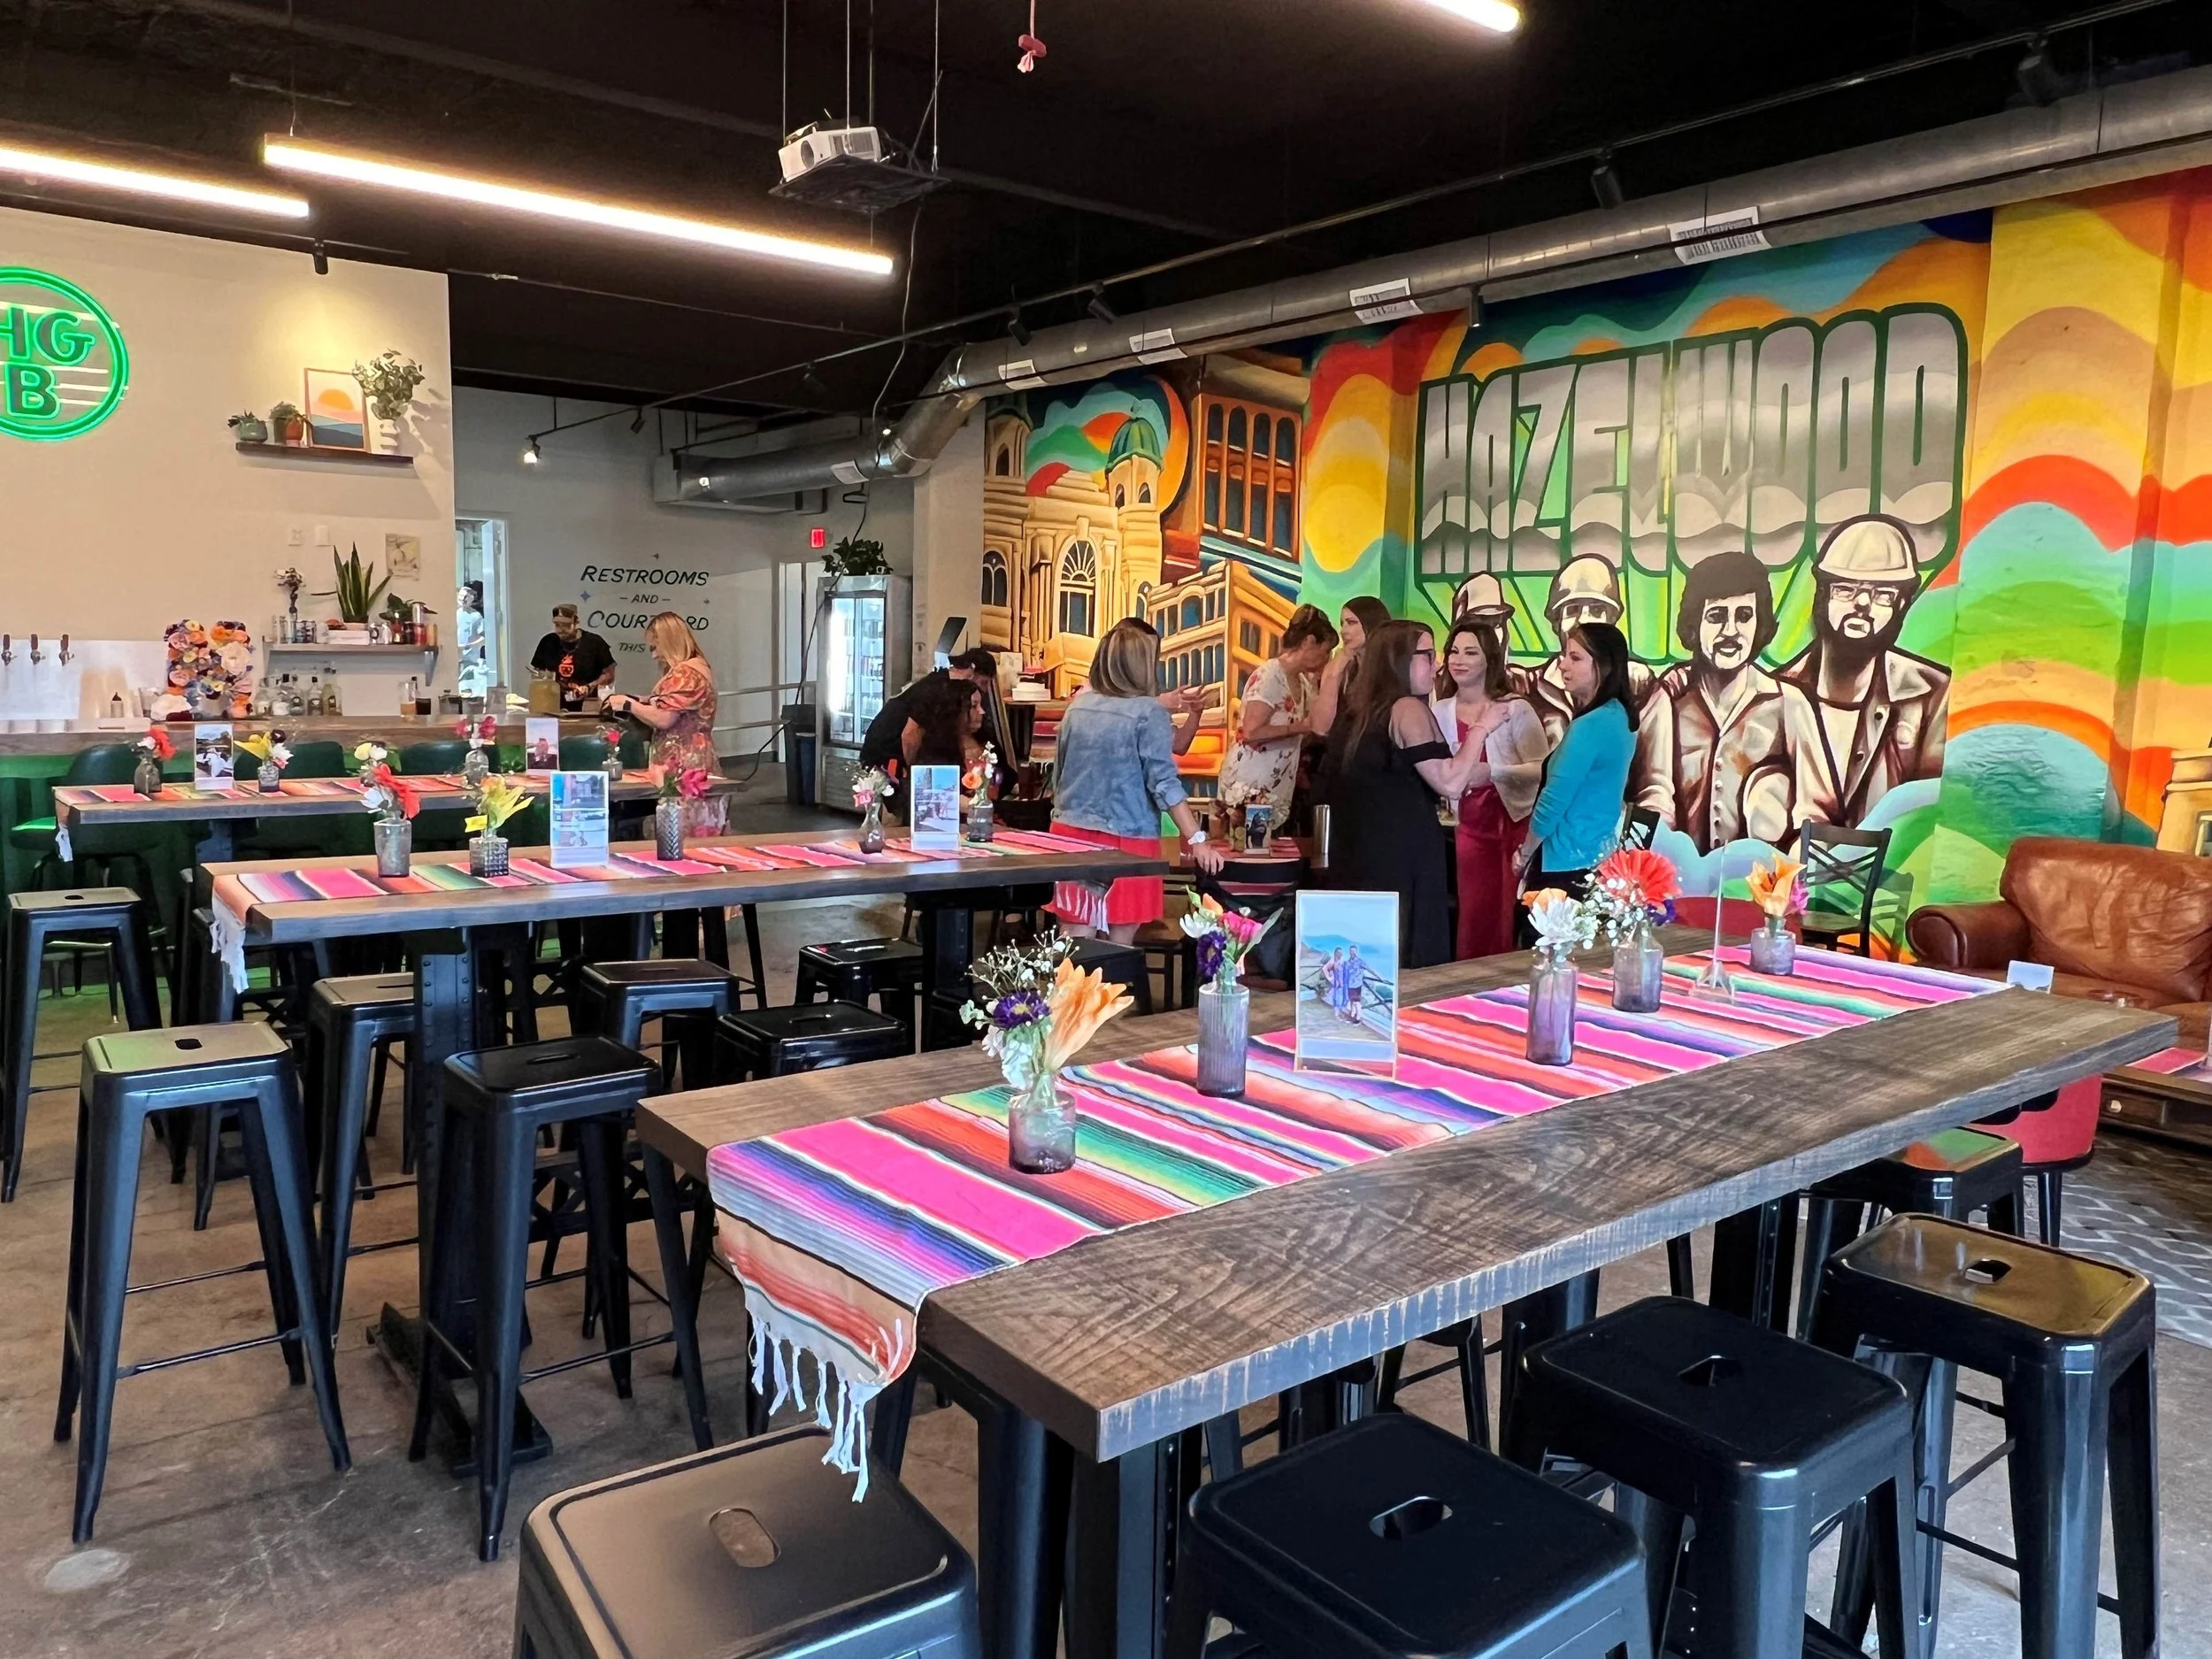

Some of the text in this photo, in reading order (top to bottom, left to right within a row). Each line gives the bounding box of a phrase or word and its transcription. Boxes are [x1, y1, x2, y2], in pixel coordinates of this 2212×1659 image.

[5, 362, 60, 419] B
[1417, 303, 1968, 580] HAZELWOOD
[580, 565, 710, 587] RESTROOMS
[631, 594, 659, 603] AND
[588, 610, 709, 631] COURRD
[619, 642, 646, 653] THIS
